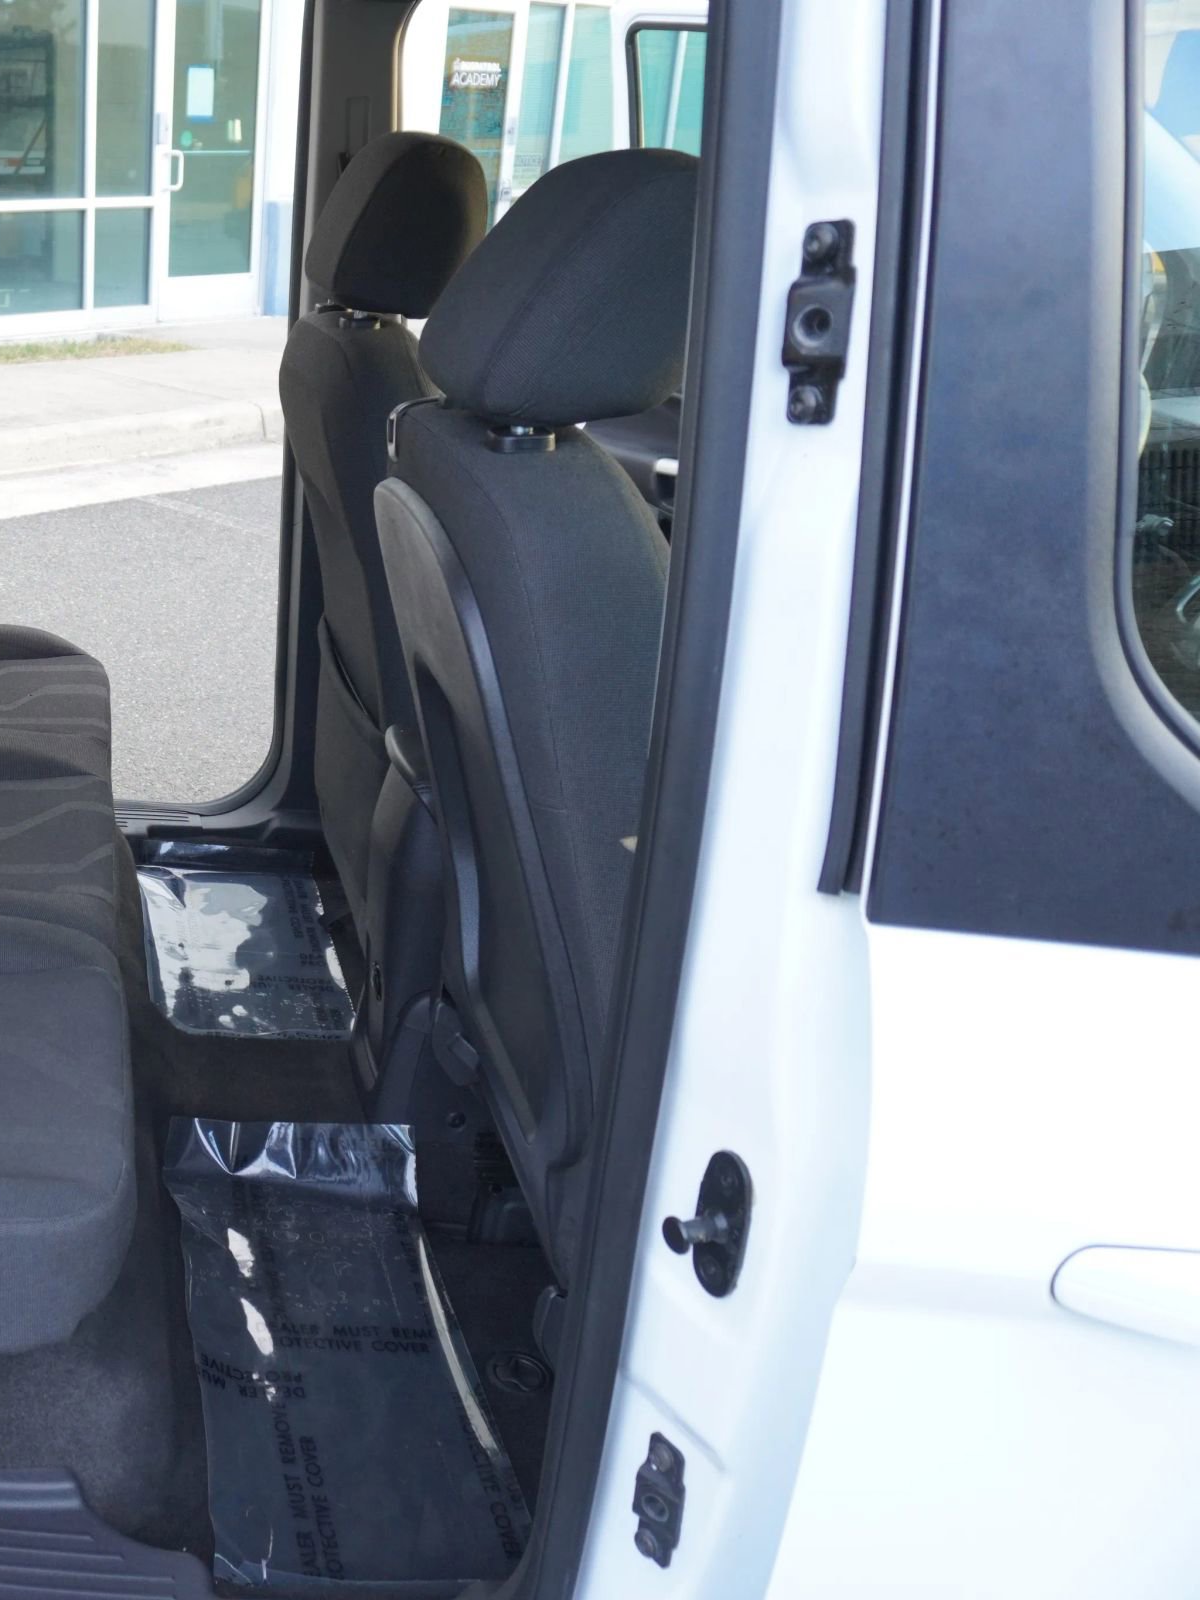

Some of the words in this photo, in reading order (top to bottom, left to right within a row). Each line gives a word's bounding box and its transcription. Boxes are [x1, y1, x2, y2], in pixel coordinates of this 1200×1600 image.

[450, 71, 502, 87] ACADEMY
[261, 1335, 362, 1353] OTECTIVE
[372, 1340, 431, 1354] COVER
[333, 1324, 381, 1338] MUST
[271, 1401, 297, 1465] REMOVE
[298, 1435, 325, 1487] COVER
[283, 1473, 309, 1519] MUST
[490, 1501, 524, 1560] COVER
